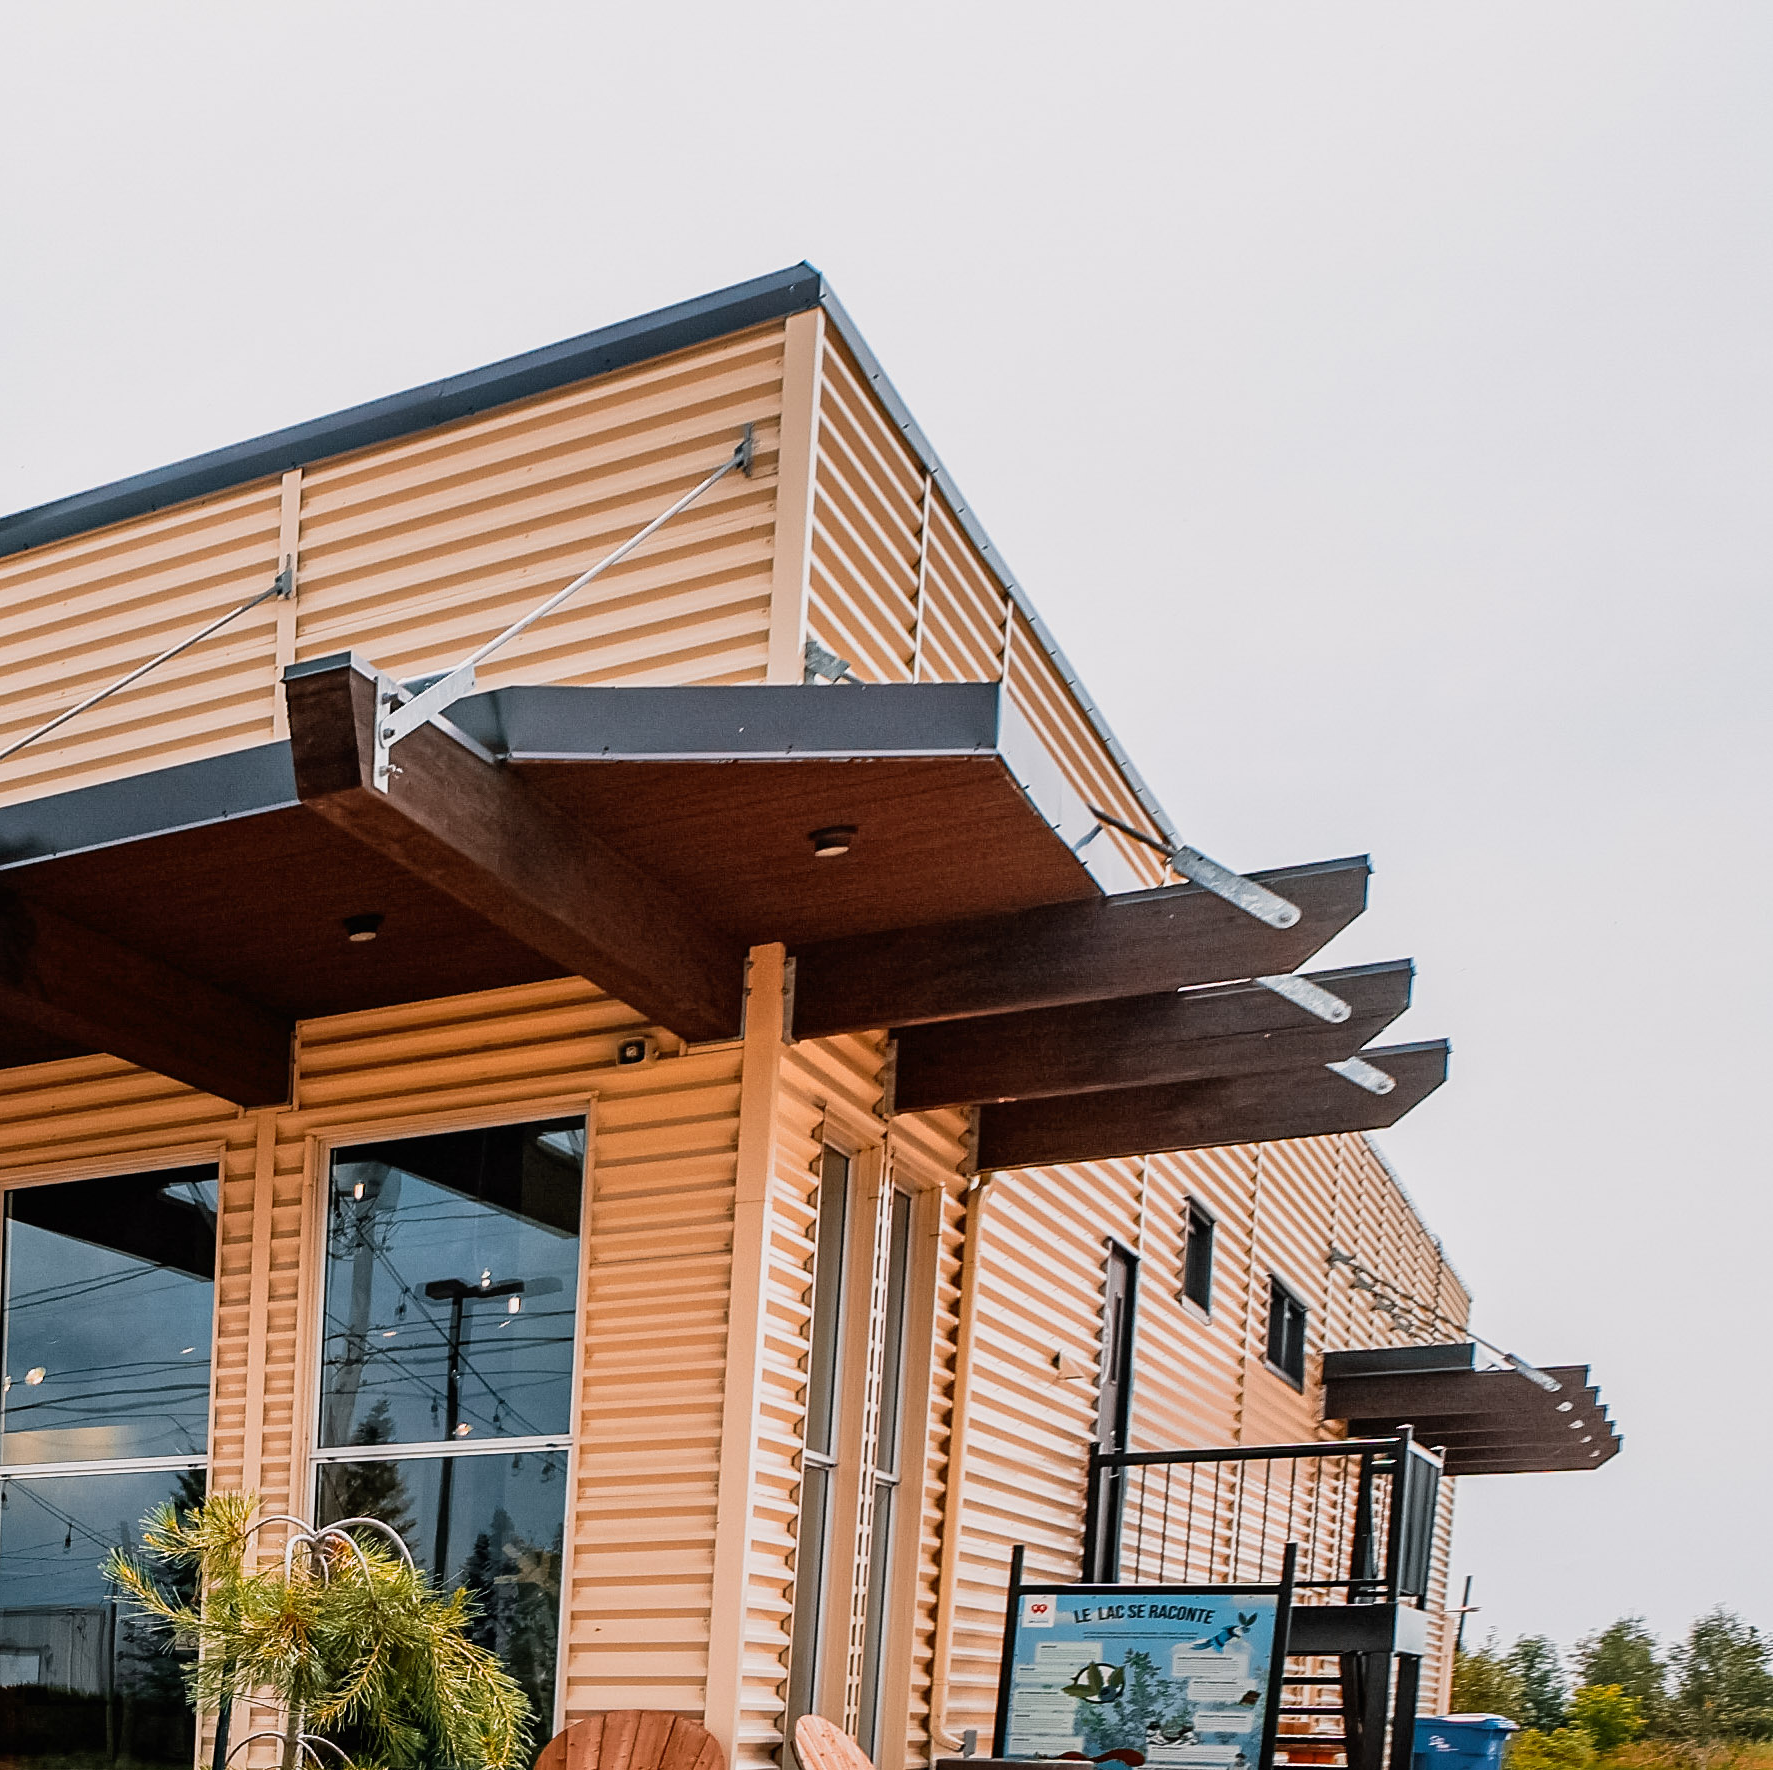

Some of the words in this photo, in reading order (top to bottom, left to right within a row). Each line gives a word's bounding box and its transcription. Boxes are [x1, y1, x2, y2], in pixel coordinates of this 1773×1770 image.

[1073, 1607, 1092, 1624] LE
[1097, 1604, 1126, 1620] LAC
[1127, 1603, 1145, 1619] SE
[1148, 1603, 1217, 1625] RACONTE
